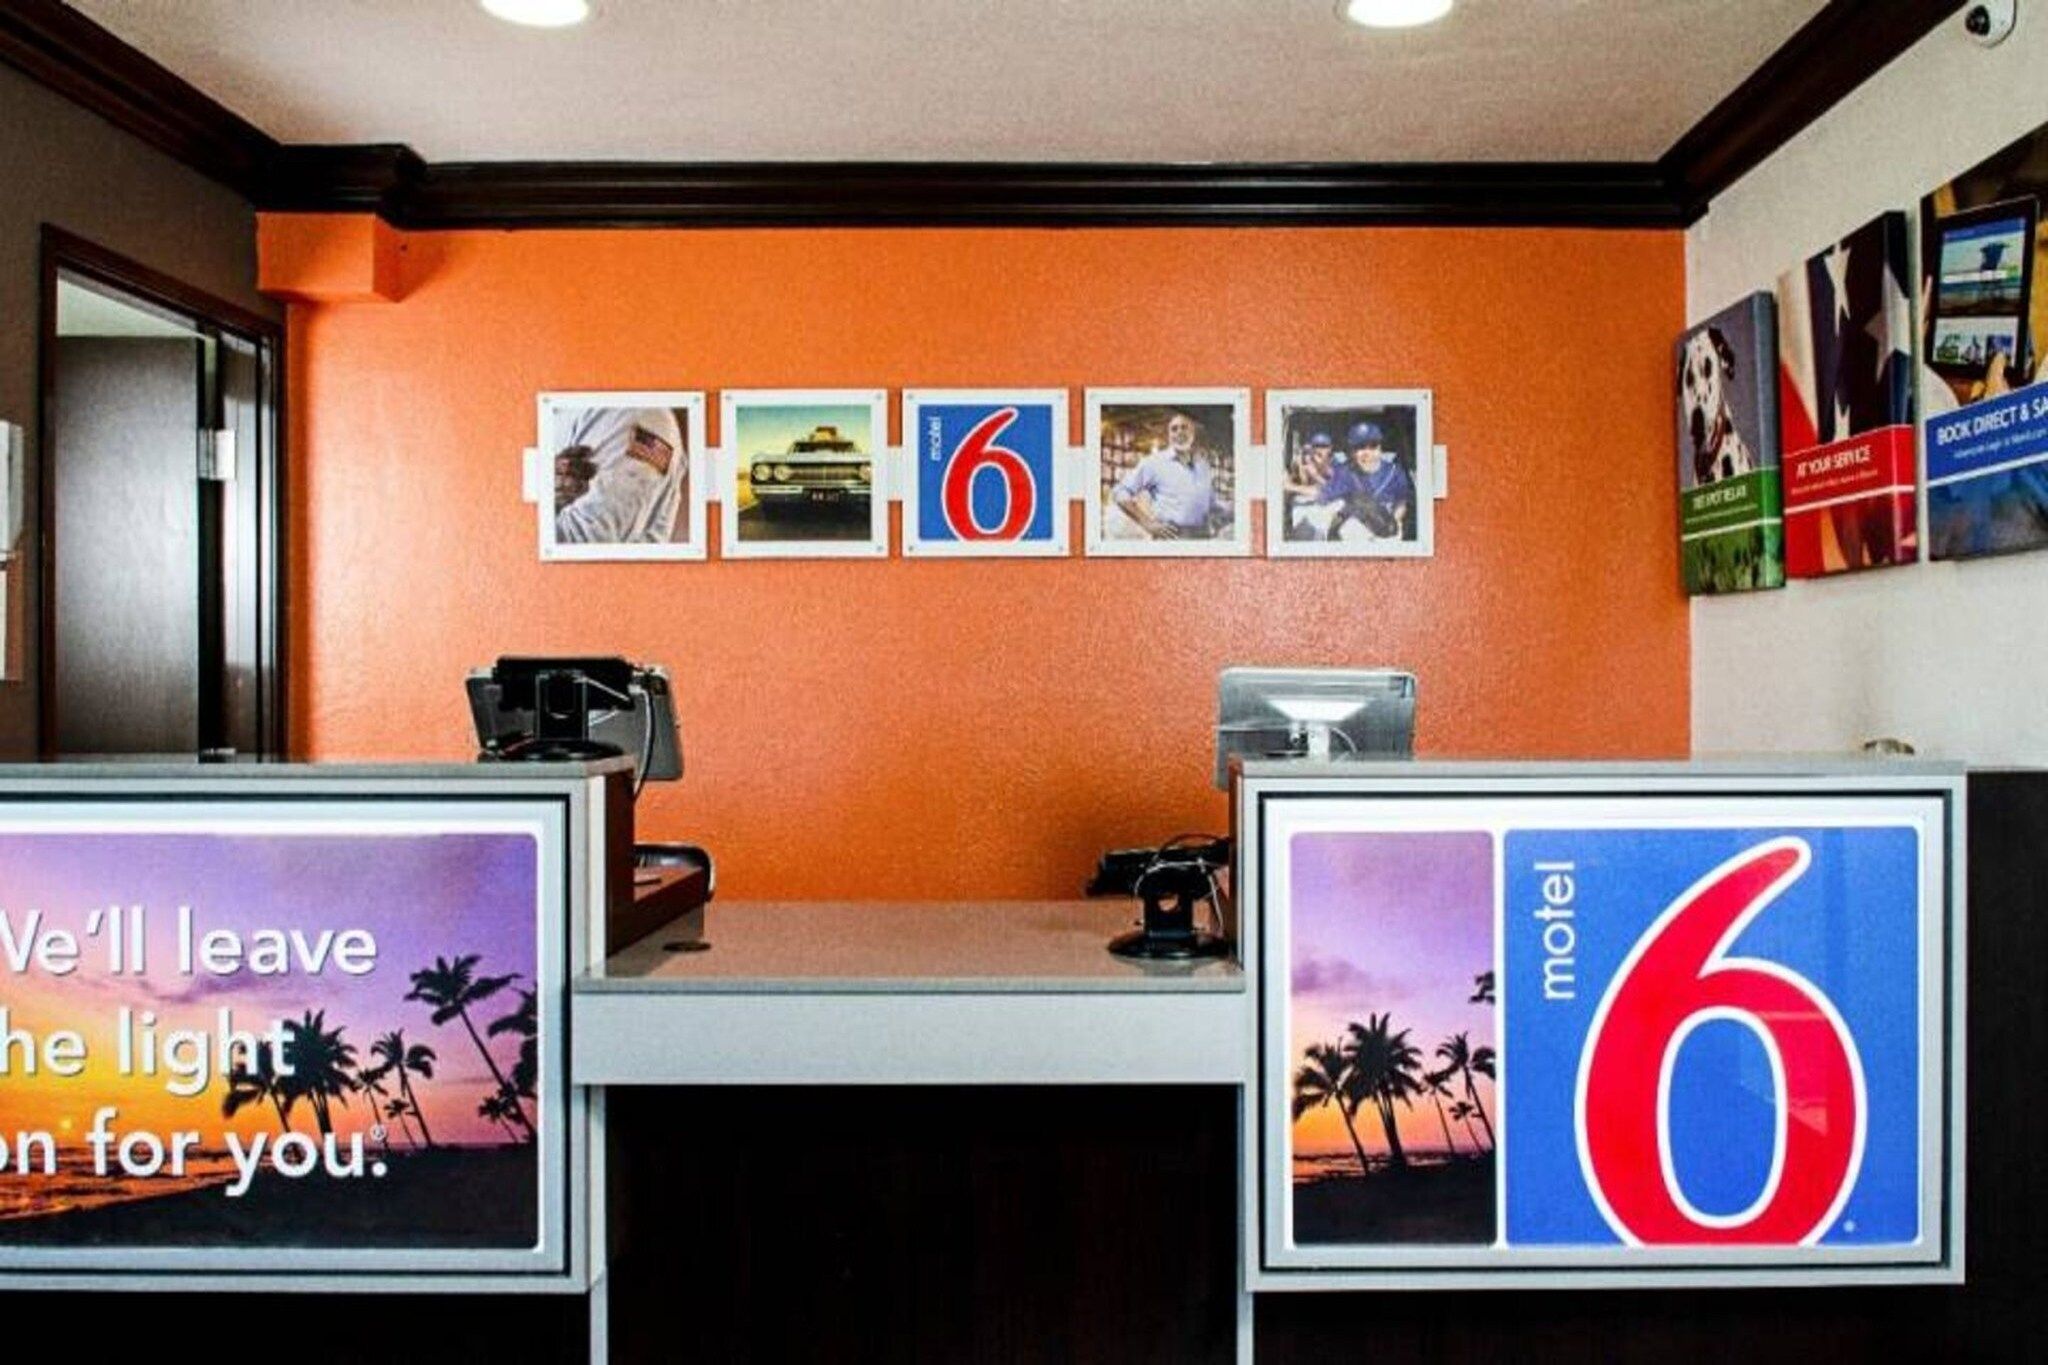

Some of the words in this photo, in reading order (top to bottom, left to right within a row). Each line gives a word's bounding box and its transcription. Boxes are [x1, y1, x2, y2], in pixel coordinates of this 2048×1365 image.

[941, 406, 1036, 542] 6
[178, 906, 378, 976] leave
[119, 1007, 296, 1096] light
[1533, 860, 1575, 1000] motel
[1573, 835, 1867, 1249] 6
[86, 1106, 200, 1177] for
